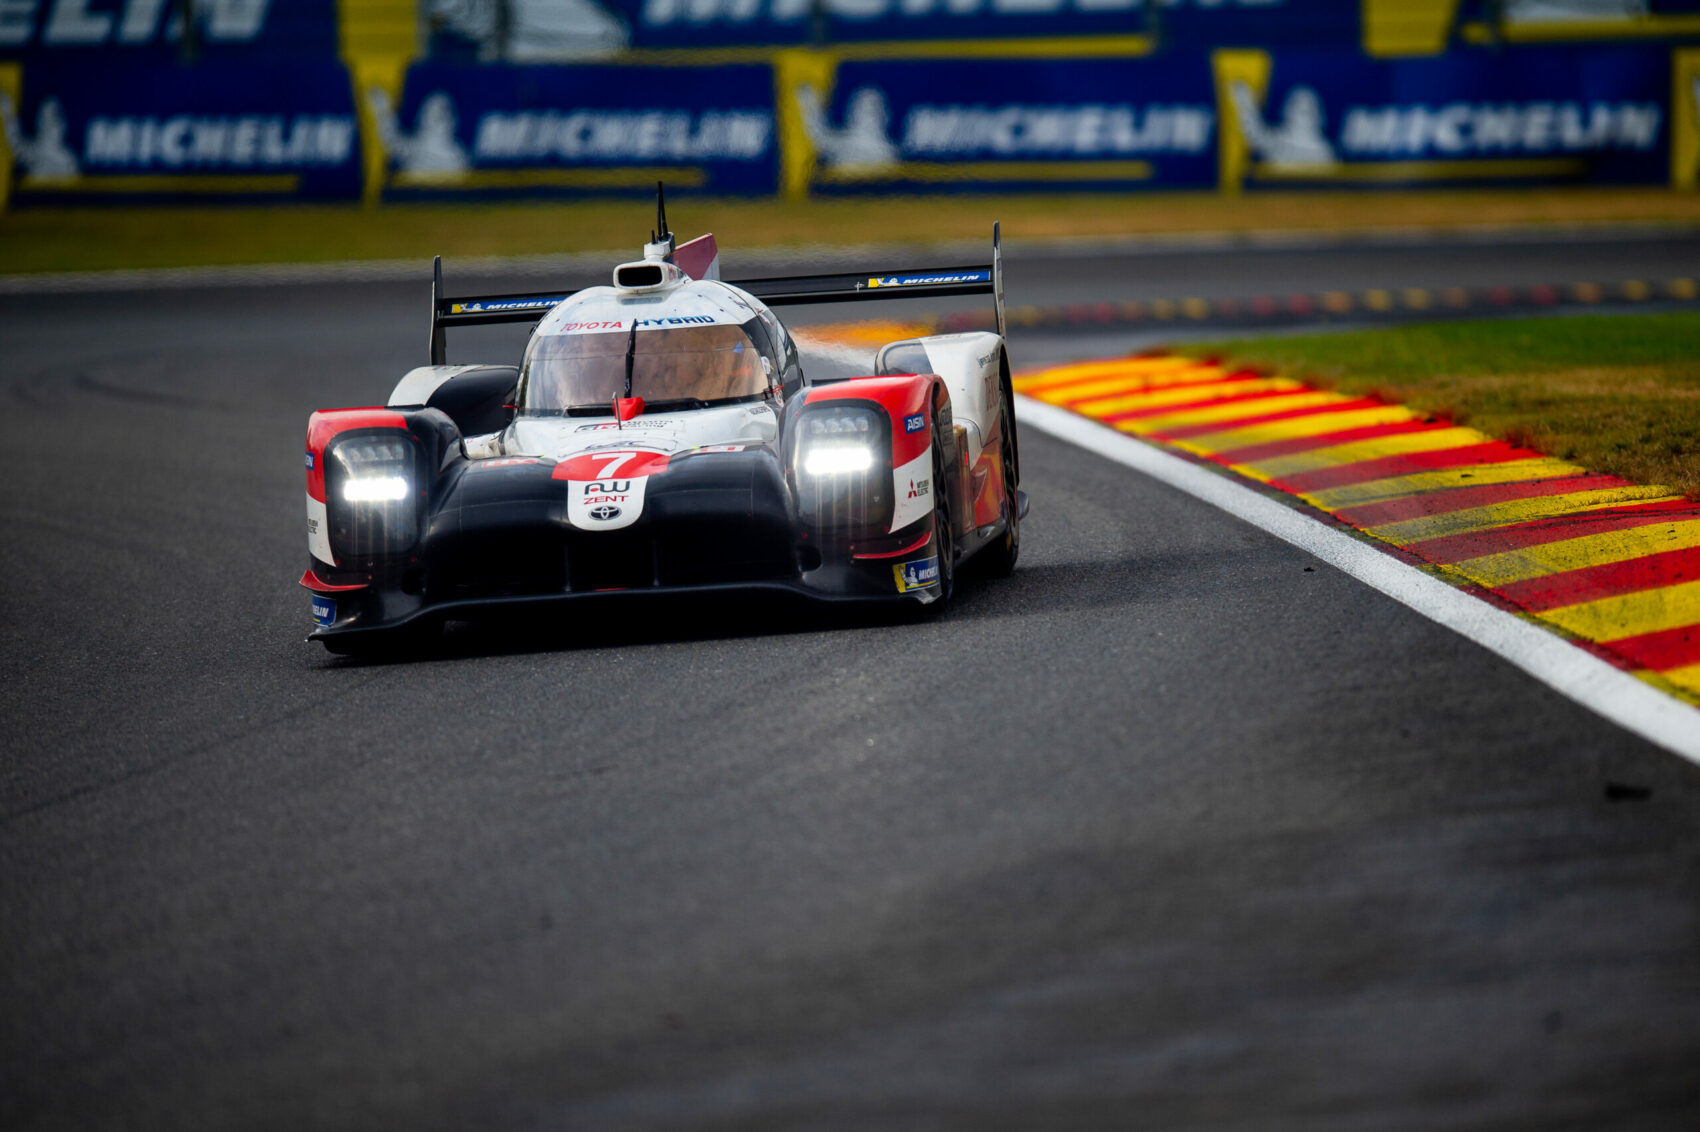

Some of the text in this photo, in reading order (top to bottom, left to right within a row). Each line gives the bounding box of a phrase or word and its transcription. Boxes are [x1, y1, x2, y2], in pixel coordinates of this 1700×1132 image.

[86, 115, 354, 164] MICHELIN
[475, 111, 770, 160] MICHELIN
[904, 106, 1212, 153] MICHELIN
[1342, 105, 1660, 151] MICHELIN
[903, 275, 980, 284] MICHELIN
[560, 315, 715, 332] TOYOTA HYBRID
[906, 415, 924, 431] AISIN
[591, 452, 637, 480] 7
[583, 495, 630, 505] ZENT
